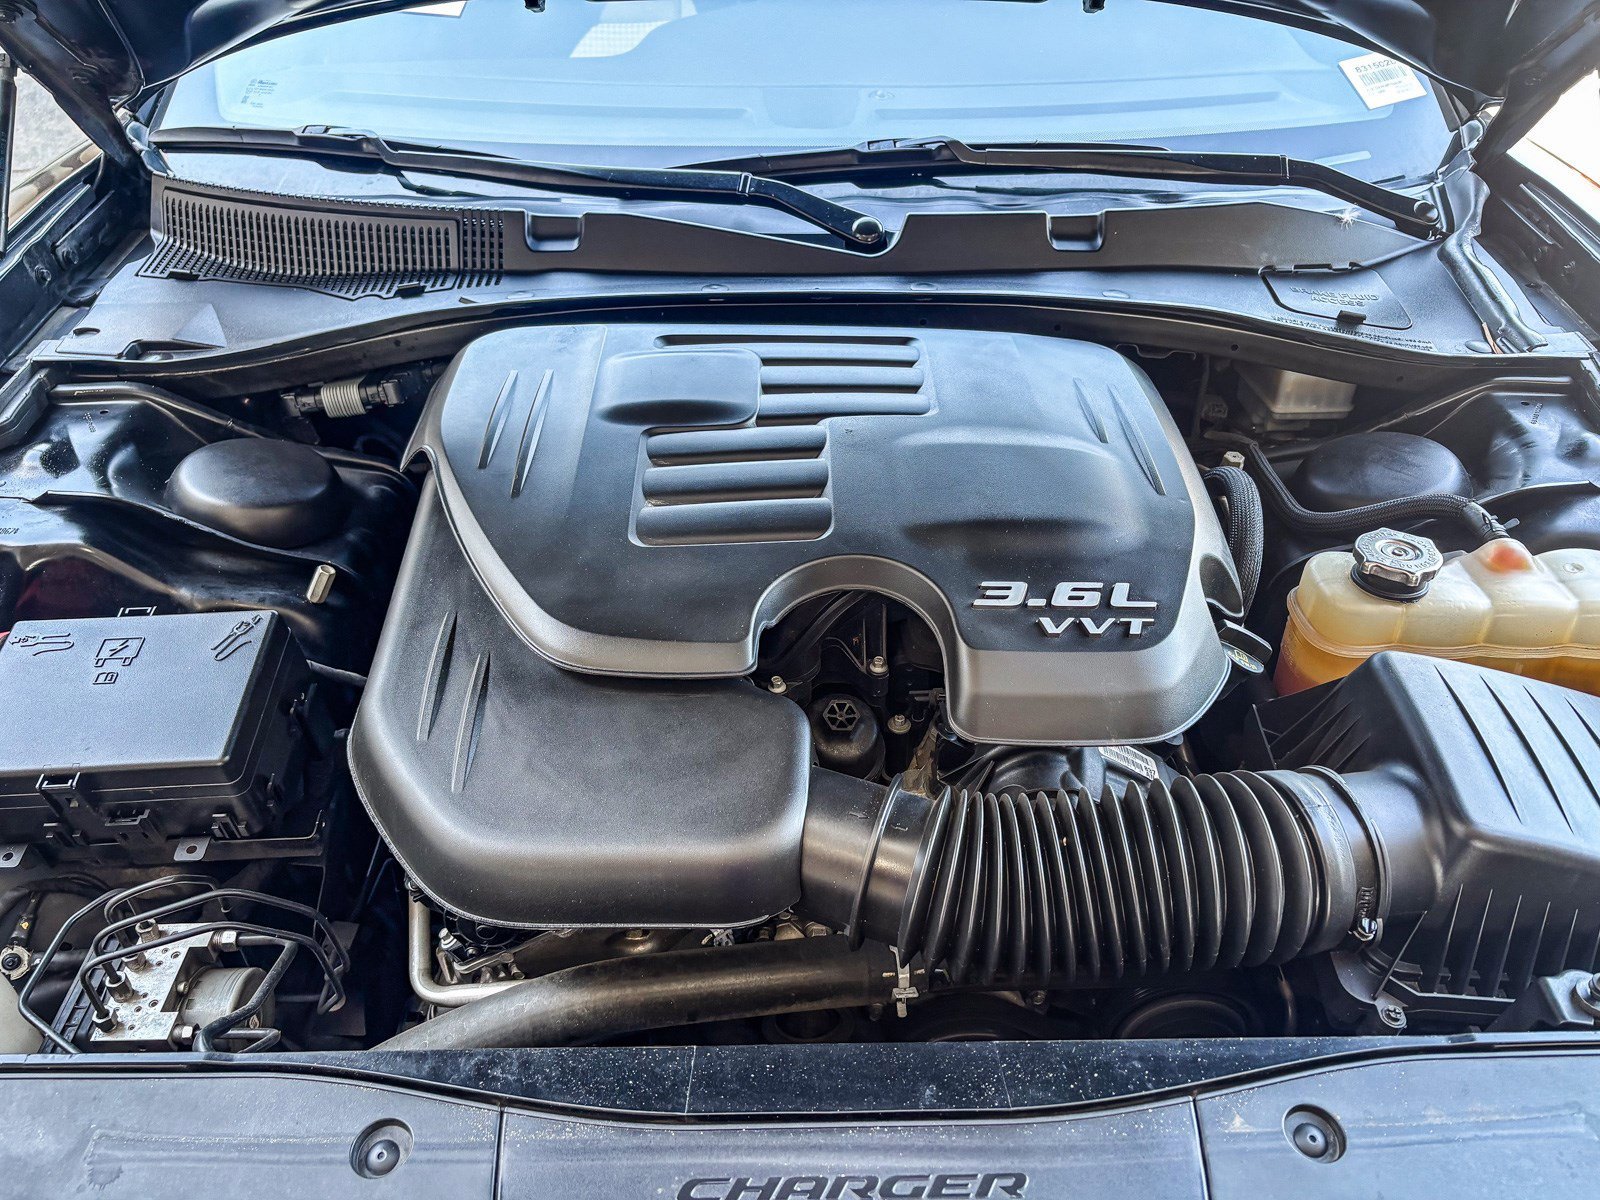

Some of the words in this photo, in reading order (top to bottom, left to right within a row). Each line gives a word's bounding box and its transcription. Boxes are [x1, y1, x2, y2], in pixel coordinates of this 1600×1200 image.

[1289, 286, 1337, 298] BRAKE
[1338, 292, 1379, 301] FLUID
[1311, 296, 1365, 307] ACCESS
[972, 581, 1158, 609] 3.6L
[1036, 617, 1155, 638] VVT
[677, 1172, 1029, 1200] CHARGER
